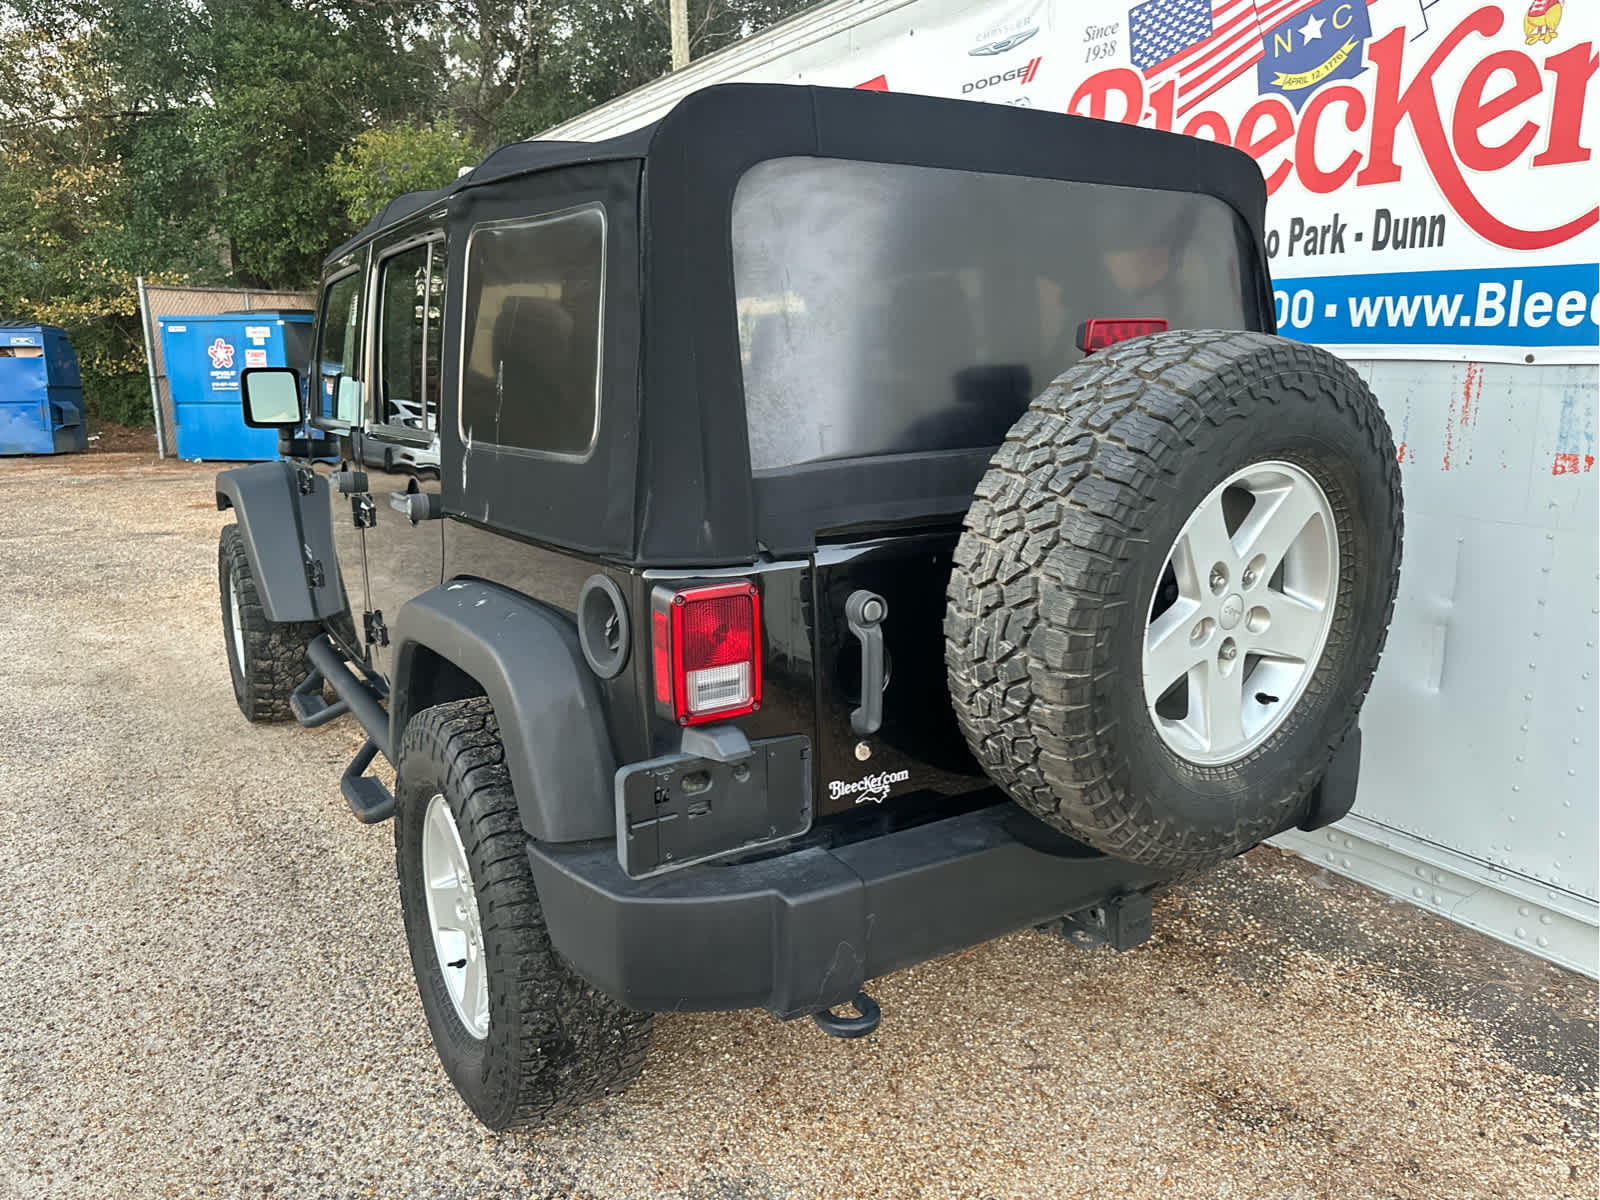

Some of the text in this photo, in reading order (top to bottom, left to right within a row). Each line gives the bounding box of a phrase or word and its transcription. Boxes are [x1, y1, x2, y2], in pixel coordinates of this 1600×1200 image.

[1083, 22, 1119, 43] Since
[1274, 3, 1352, 58] N C
[1084, 40, 1117, 63] 1938
[962, 65, 1029, 94] DODGE
[1288, 213, 1347, 257] Park
[1371, 208, 1446, 251] Dunn
